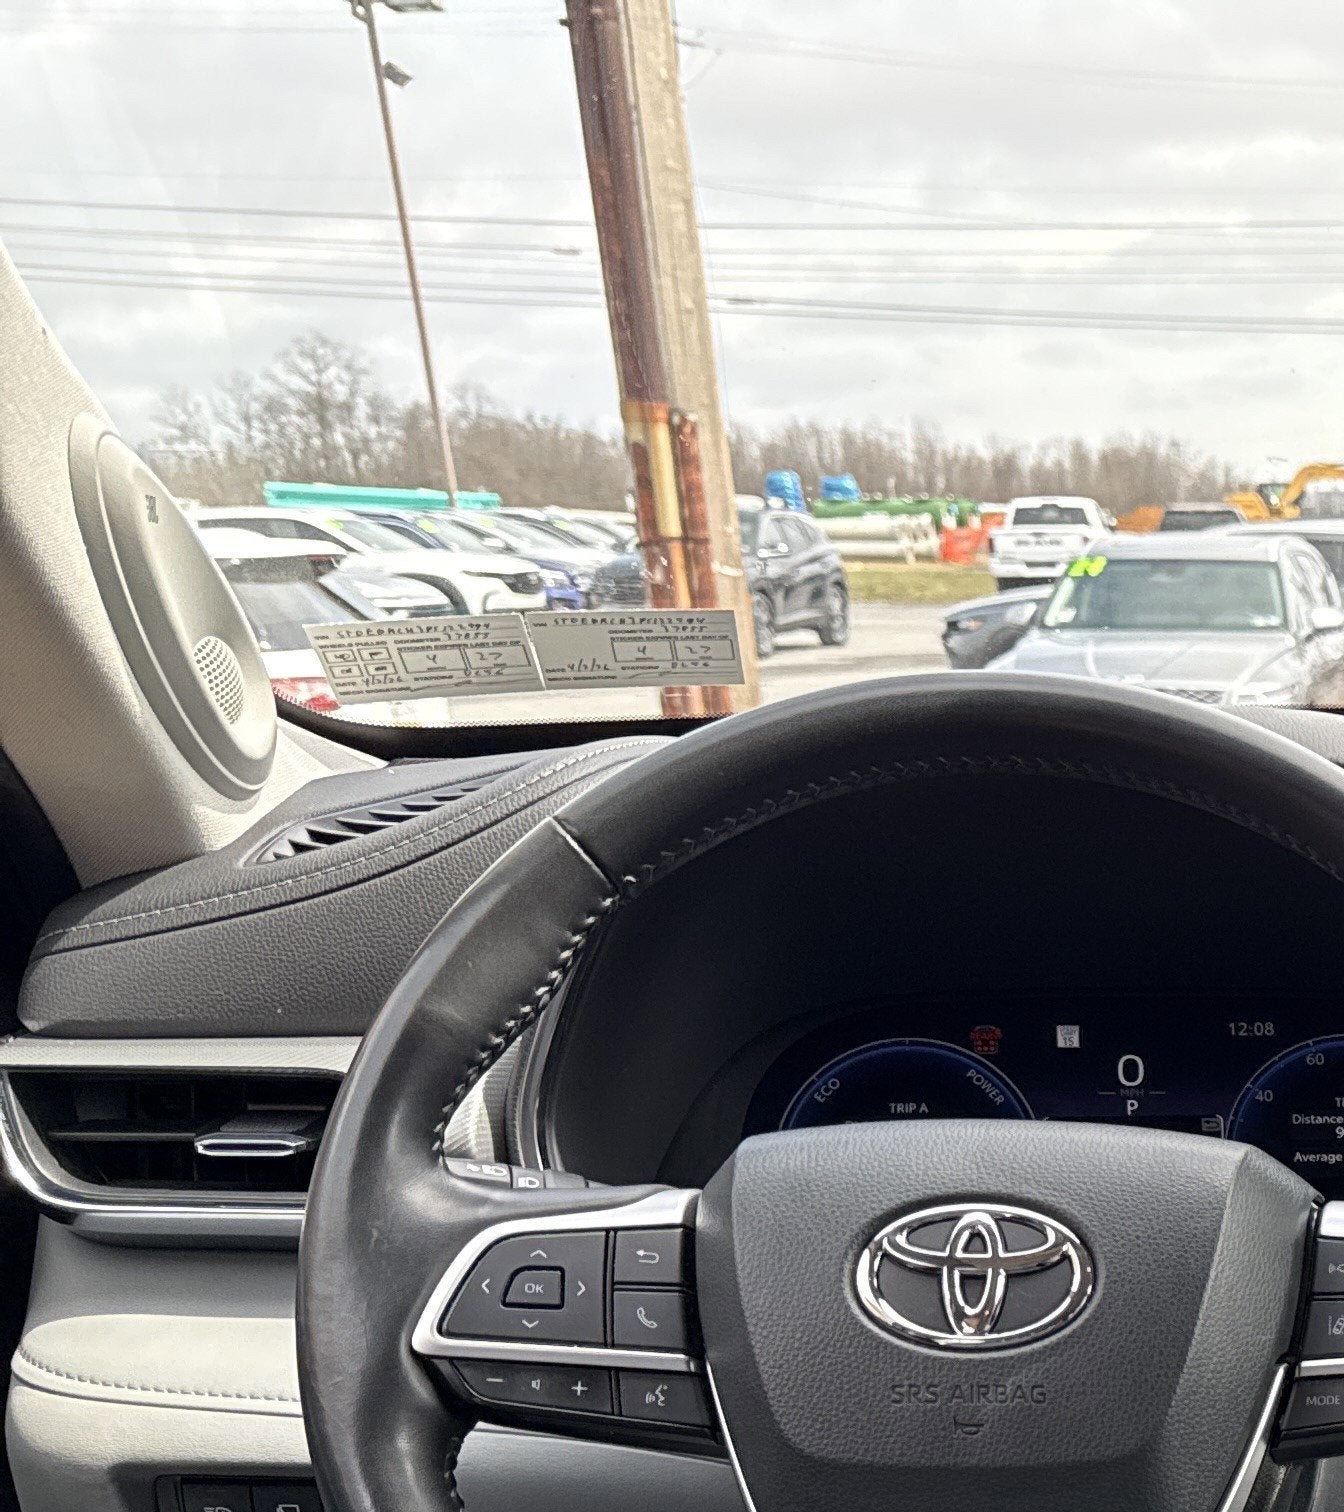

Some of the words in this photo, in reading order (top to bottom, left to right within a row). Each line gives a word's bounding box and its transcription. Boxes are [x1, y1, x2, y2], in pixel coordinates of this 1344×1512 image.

[1228, 1021, 1275, 1037] 12:08
[1305, 1052, 1325, 1066] 60
[1117, 1054, 1145, 1087] 0
[813, 1077, 841, 1104] ECO
[966, 1068, 1005, 1106] POWER
[1254, 1089, 1274, 1102] 40
[889, 1102, 917, 1114] TRIP
[919, 1102, 930, 1114] A
[1126, 1099, 1139, 1116] P
[1291, 1114, 1344, 1125] Distance
[1293, 1151, 1343, 1164] Average
[524, 1282, 544, 1294] OK
[891, 1384, 940, 1405] SRS
[951, 1384, 1047, 1405] AIRBAG
[1305, 1395, 1341, 1406] MODE
